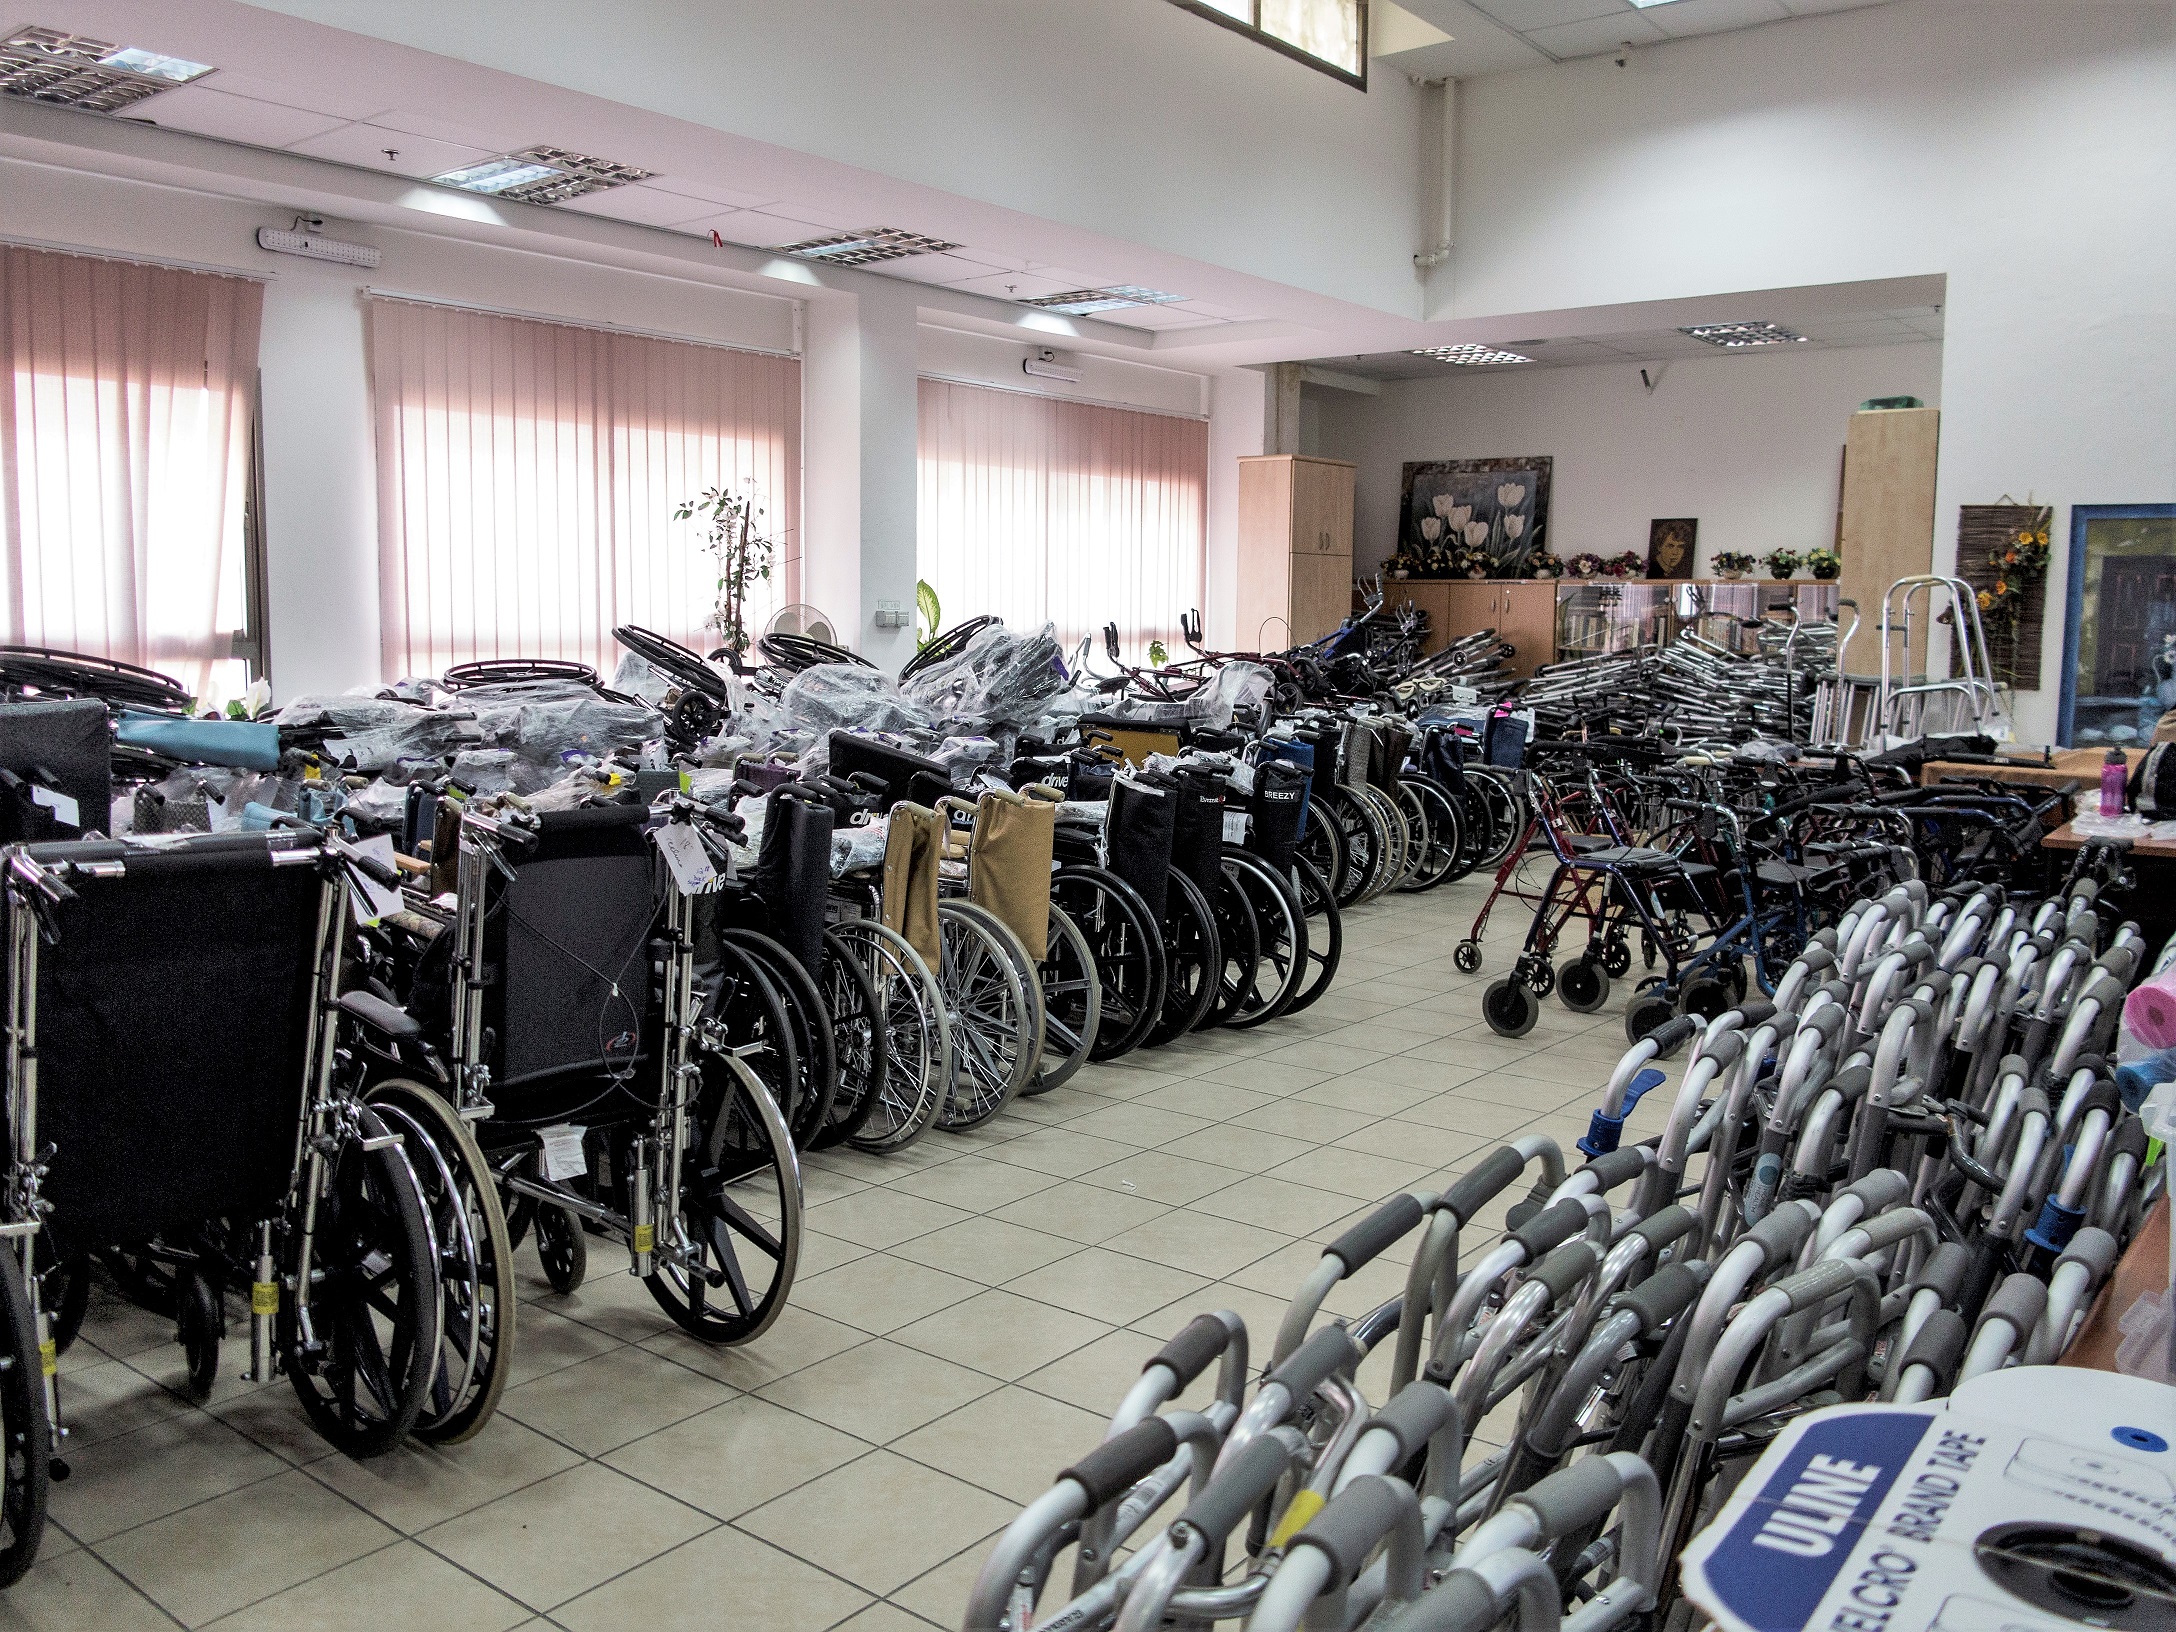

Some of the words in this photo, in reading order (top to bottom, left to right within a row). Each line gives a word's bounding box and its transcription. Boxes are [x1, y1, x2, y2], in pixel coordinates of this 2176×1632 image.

[1041, 772, 1069, 788] drive
[1264, 790, 1295, 800] BREEZY
[694, 873, 726, 894] rive
[1751, 1452, 1883, 1558] ULINE
[1829, 1550, 1918, 1632] ELCRO
[1885, 1472, 1961, 1544] BRAND
[1926, 1429, 1987, 1473] TAPE
